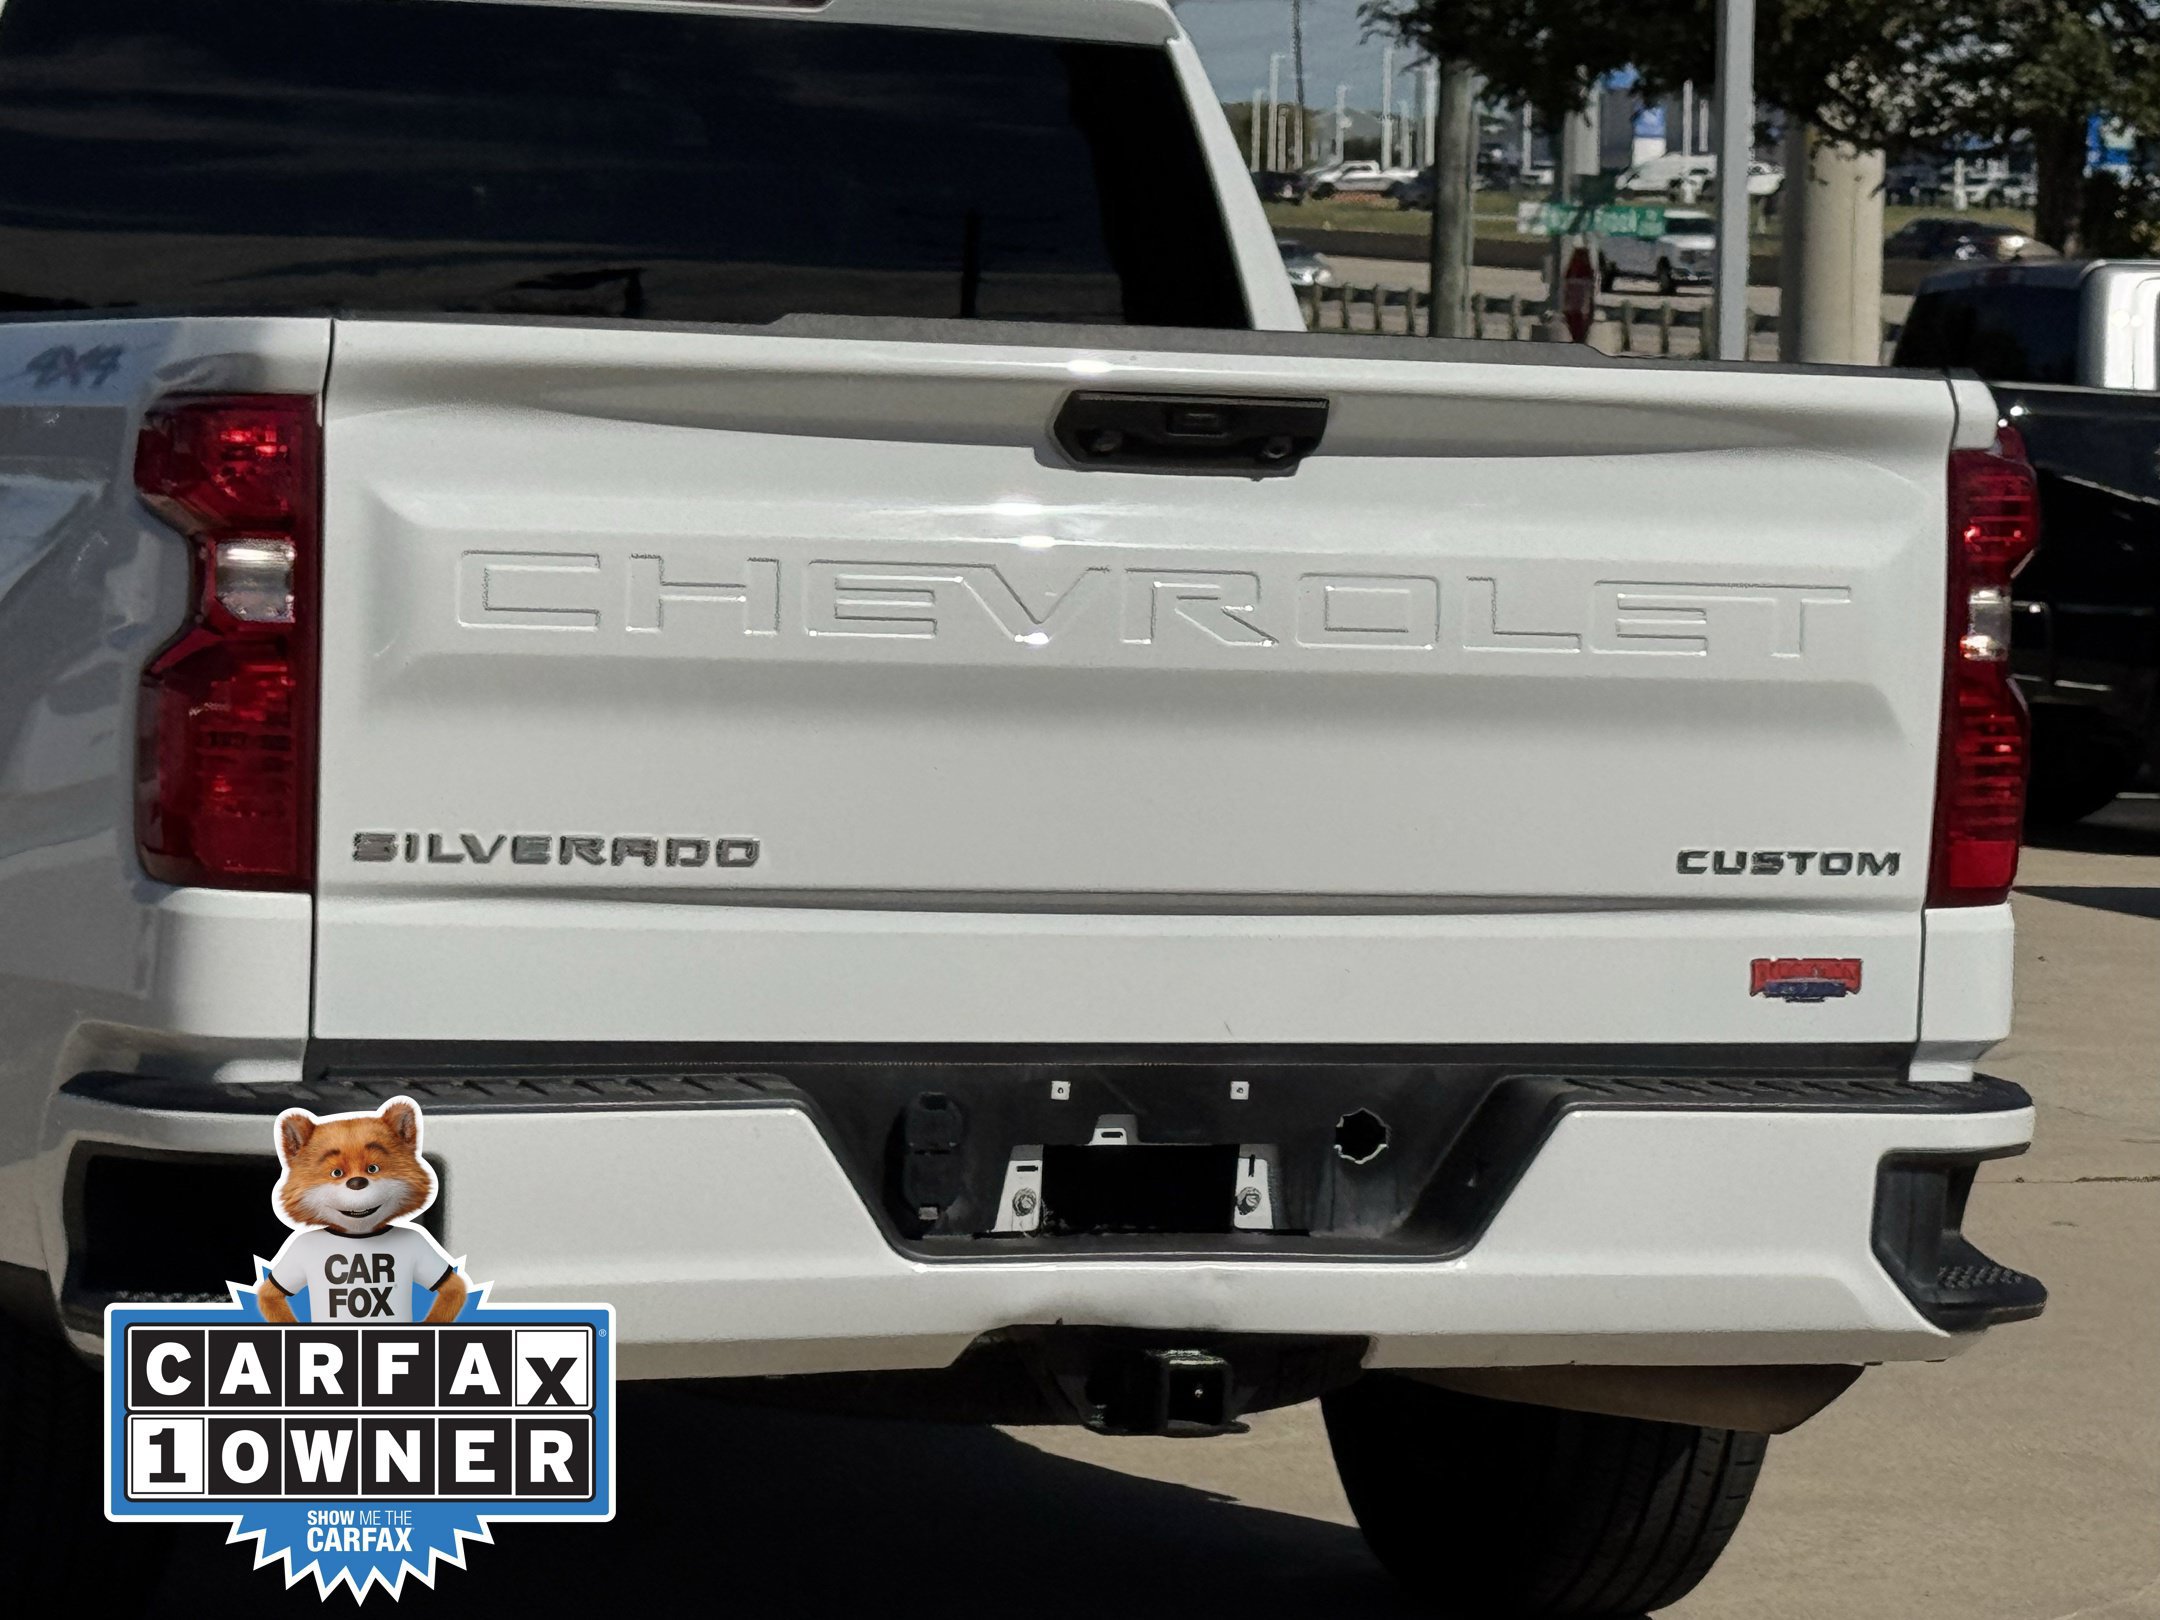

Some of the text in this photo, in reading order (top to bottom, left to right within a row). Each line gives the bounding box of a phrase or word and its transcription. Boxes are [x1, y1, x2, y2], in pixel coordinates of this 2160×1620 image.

[456, 549, 1852, 659] CHEVROLET
[352, 831, 761, 868] SILVERADO
[1676, 850, 1901, 876] CUSTOM
